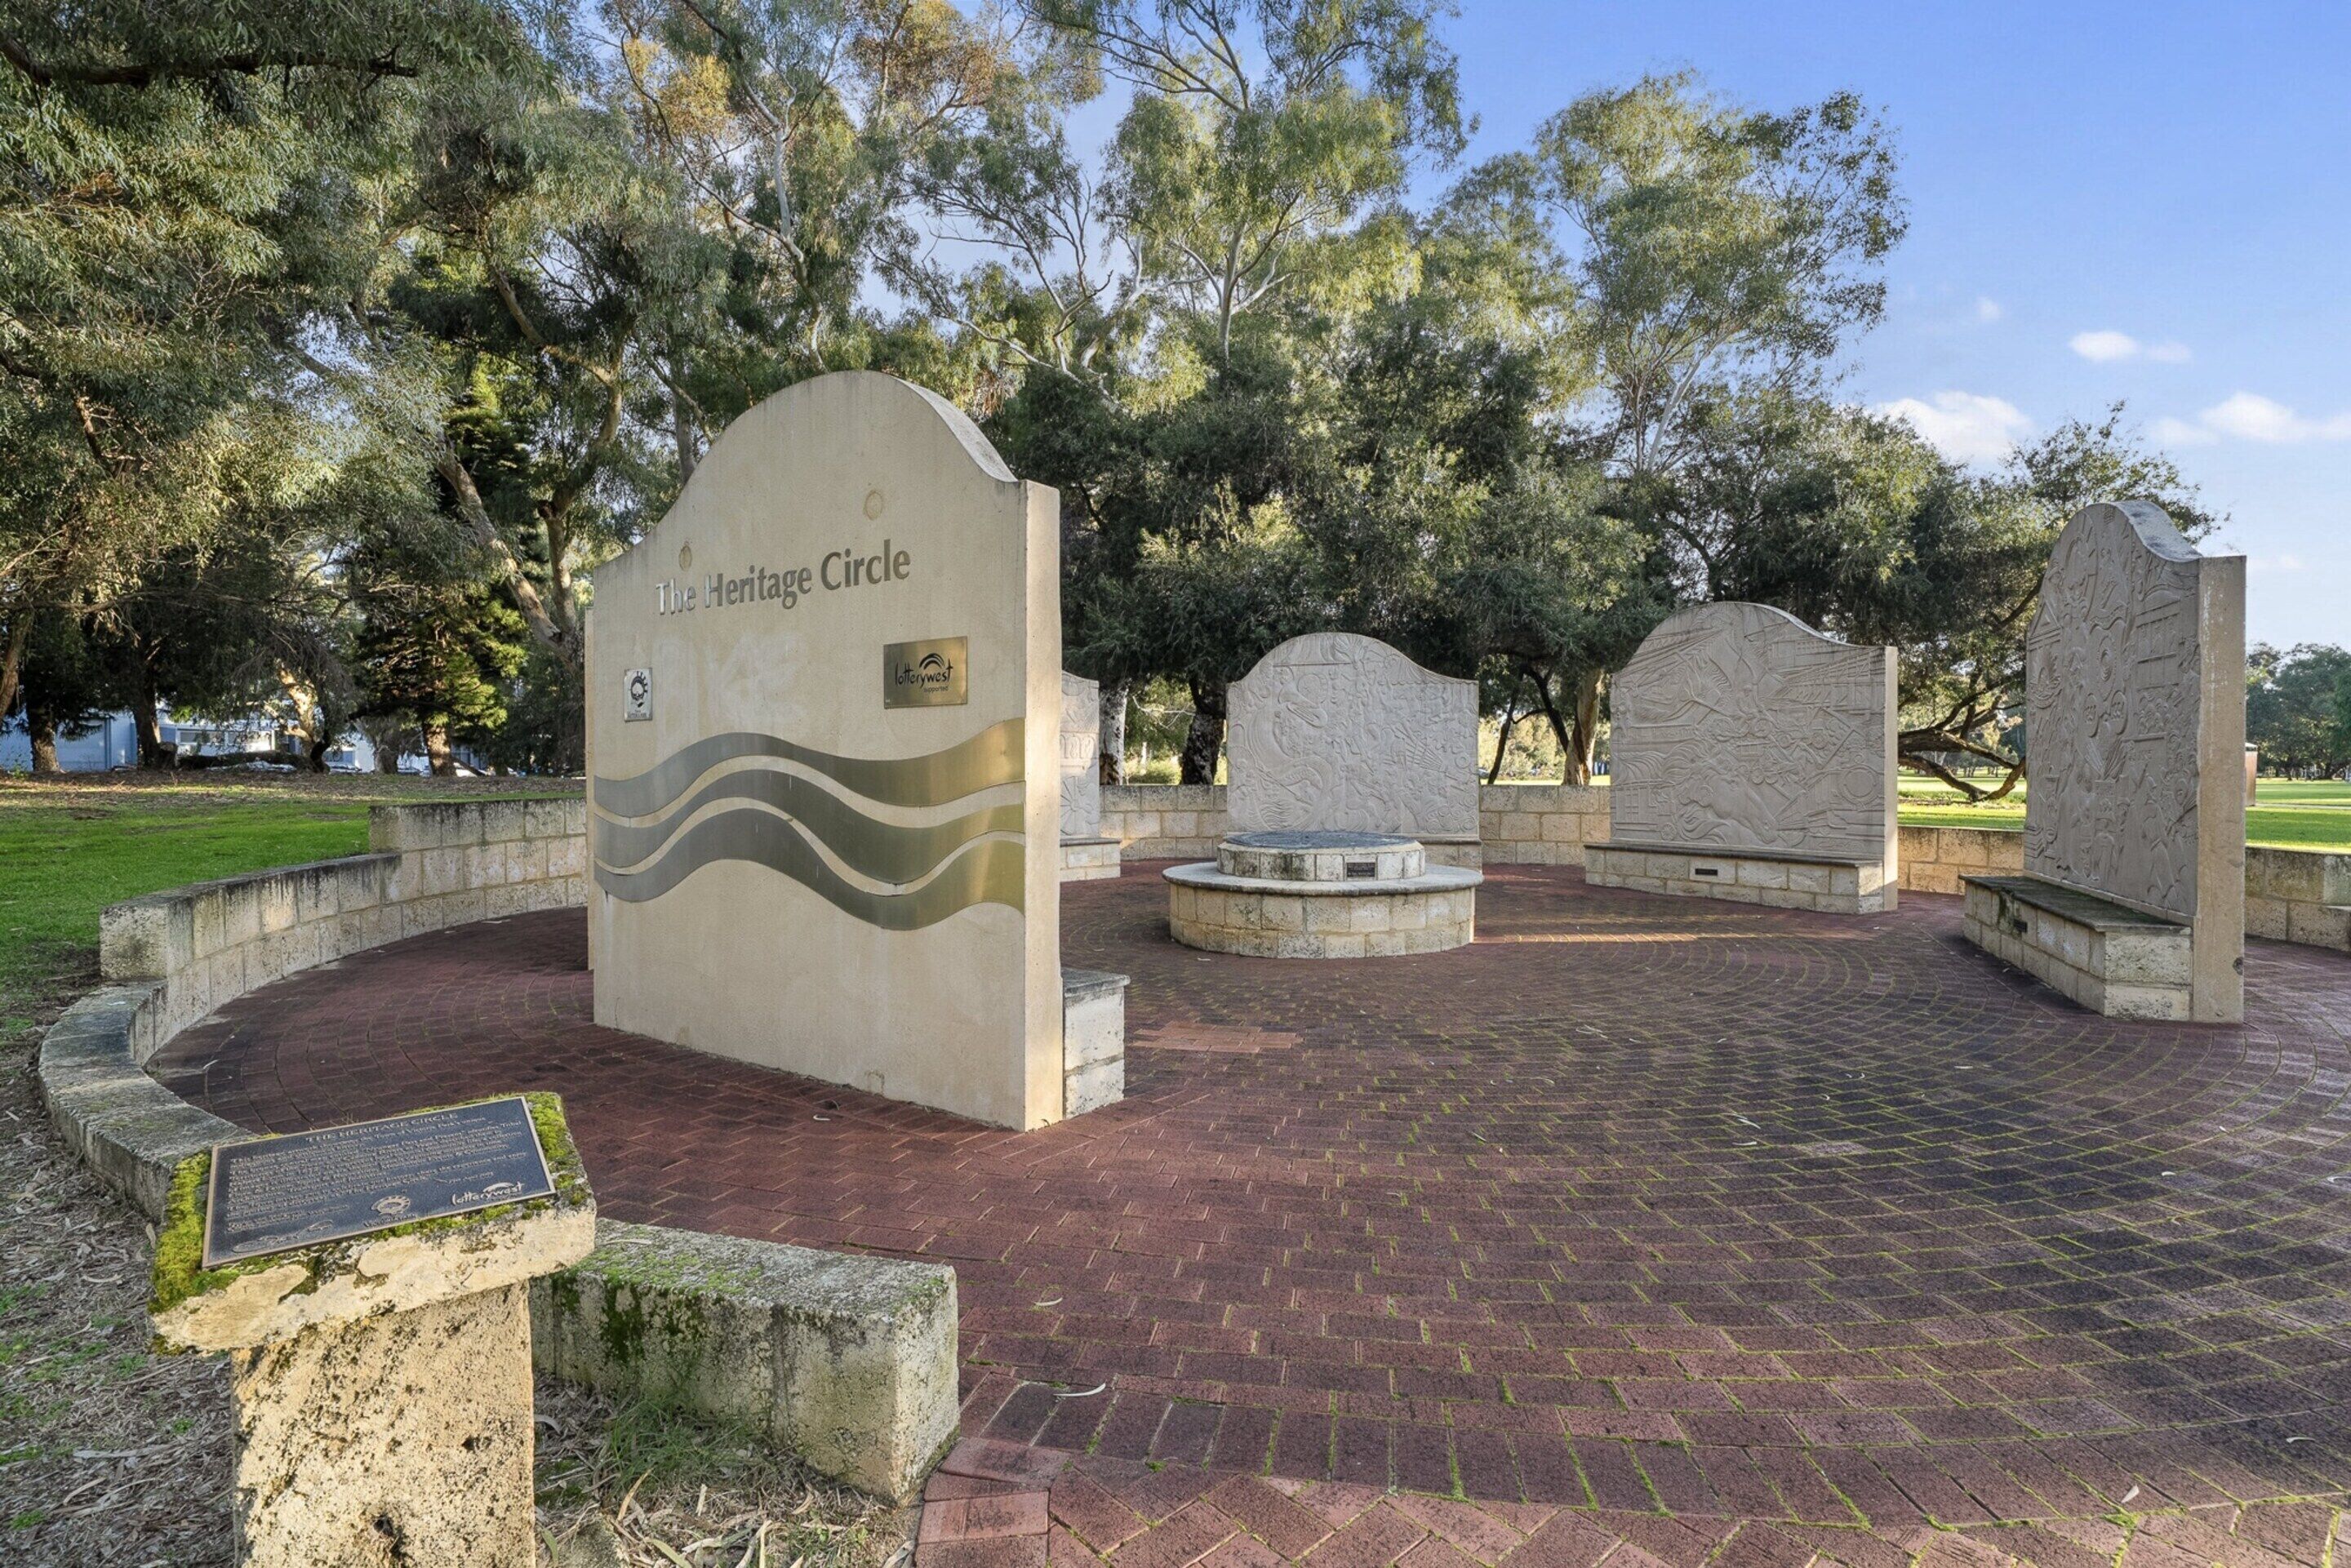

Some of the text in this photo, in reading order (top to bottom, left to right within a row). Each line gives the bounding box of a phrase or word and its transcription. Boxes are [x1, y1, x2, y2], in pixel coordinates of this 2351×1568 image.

[656, 539, 912, 615] The Heritage Circle
[895, 658, 953, 689] lotterywest
[305, 1113, 458, 1142] THE HERITAGE CIRCLE
[451, 1180, 525, 1206] lotterywest
